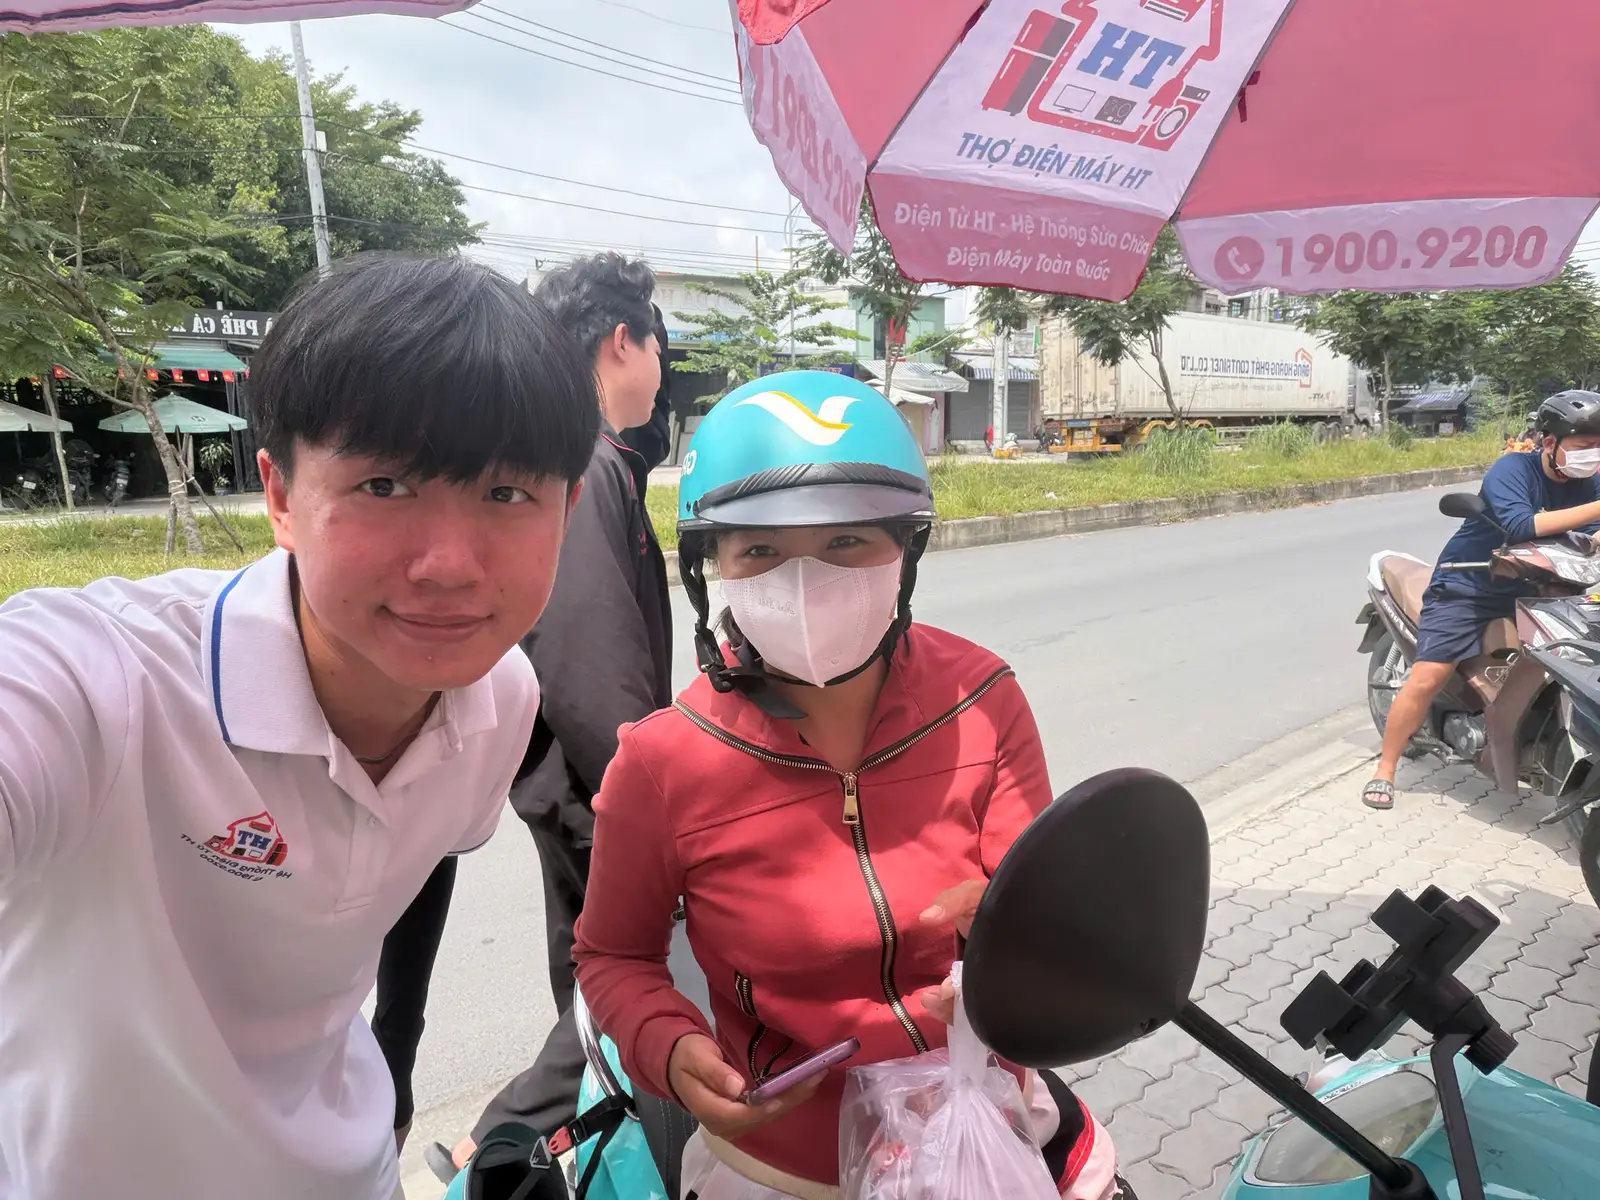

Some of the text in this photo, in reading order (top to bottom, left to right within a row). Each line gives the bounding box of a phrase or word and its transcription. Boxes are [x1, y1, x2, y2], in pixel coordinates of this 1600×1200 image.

[1076, 22, 1186, 89] HT
[957, 132, 1152, 189] THỢ ĐIỆN MÁY HT
[894, 202, 942, 232] Điện
[948, 204, 970, 229] Tử
[973, 210, 996, 231] HT
[1011, 213, 1035, 240] Hệ
[1040, 216, 1087, 247] Thống
[1090, 225, 1115, 248] Sửa
[1120, 232, 1151, 256] Chữa
[1275, 224, 1548, 277] 1900.9200
[947, 246, 1111, 282] Điện Máy Toàn Quốc
